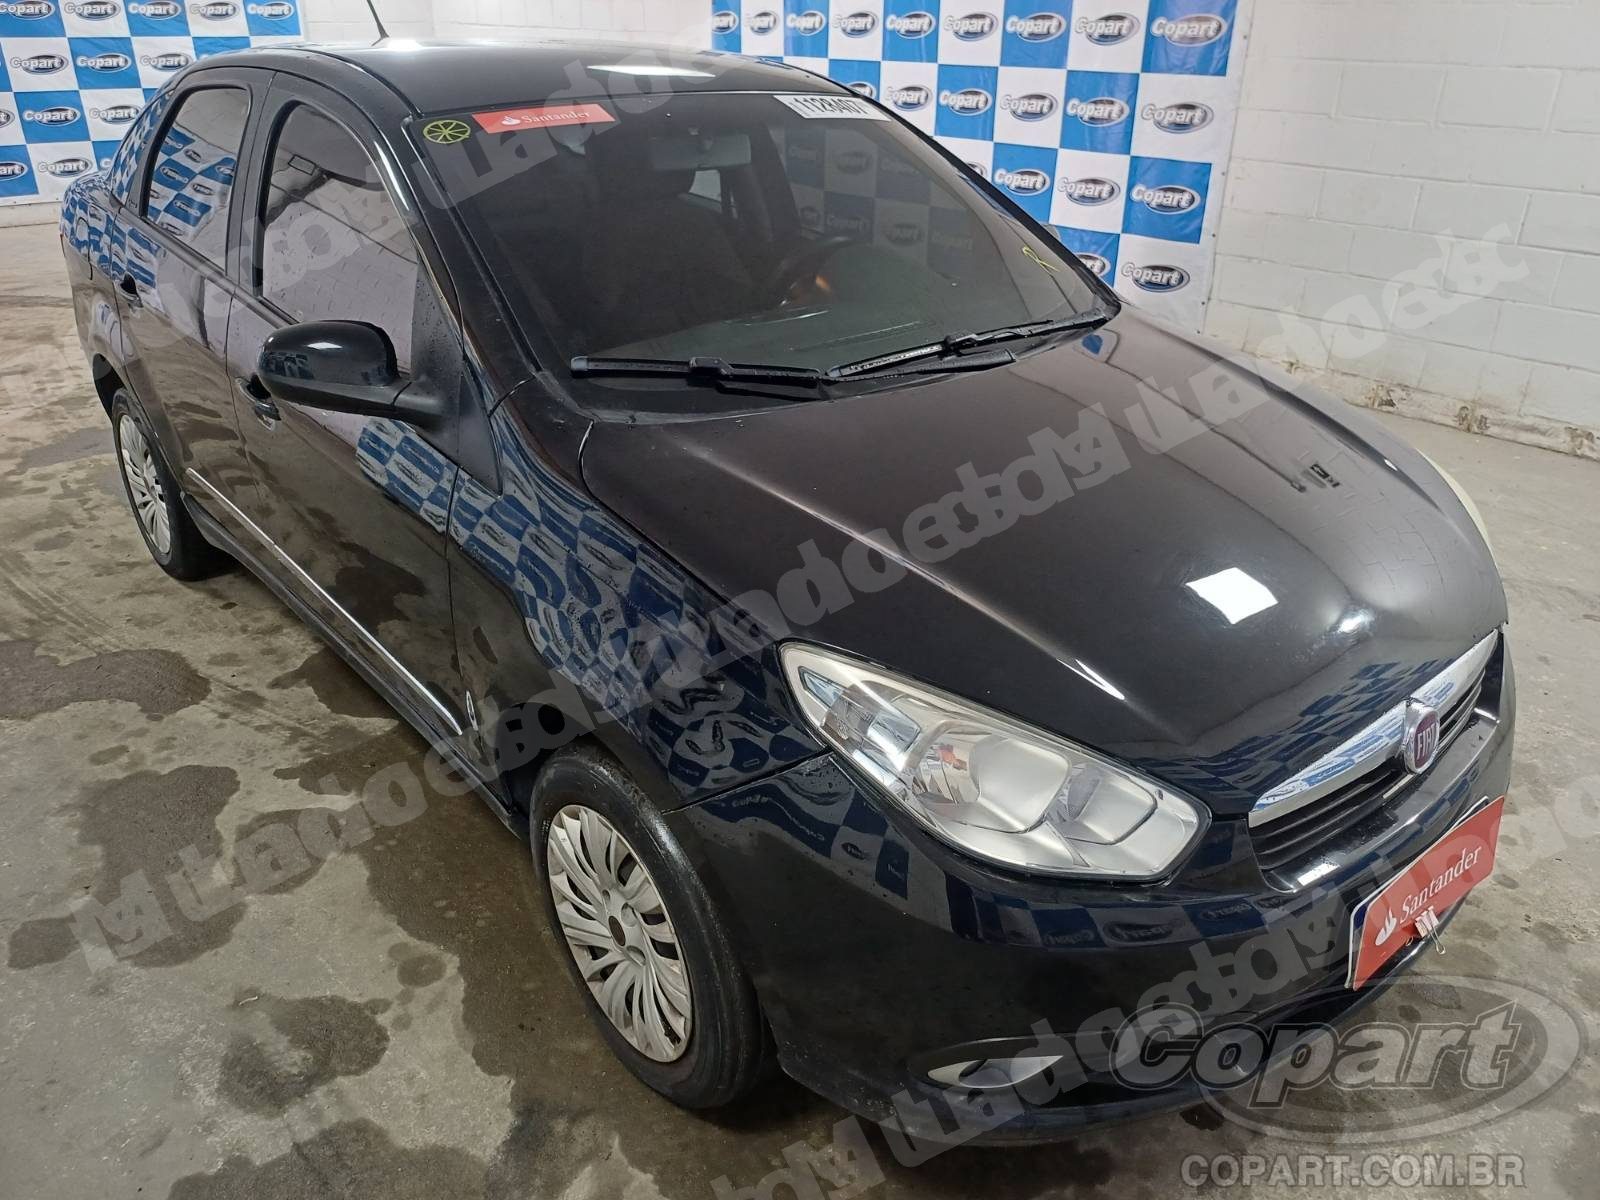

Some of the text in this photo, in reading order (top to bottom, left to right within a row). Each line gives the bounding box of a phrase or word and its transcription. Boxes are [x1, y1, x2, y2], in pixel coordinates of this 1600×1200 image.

[0, 1, 49, 15] Copart
[64, 2, 113, 15] Copart
[128, 2, 176, 16] Copart
[190, 3, 234, 17] Copart
[247, 3, 290, 17] Copart
[886, 14, 931, 32] Copart
[944, 15, 990, 34] Copart
[1006, 16, 1062, 35] Copart
[1074, 17, 1132, 37] Copart
[1151, 18, 1222, 39] Copart
[10, 56, 60, 72] Copart
[76, 55, 126, 69] Copart
[140, 55, 188, 70] Copart
[939, 90, 986, 110] Copart
[1000, 94, 1051, 114] Copart
[1067, 98, 1123, 121] Copart
[23, 109, 75, 123] Copart
[89, 107, 138, 121] Copart
[521, 110, 591, 124] Santander
[1141, 104, 1206, 127] Copart
[38, 161, 86, 175] Copart
[994, 168, 1045, 189] Copart
[1057, 177, 1113, 199] Copart
[1131, 183, 1192, 209] Copart
[1121, 262, 1181, 286] Copart
[1416, 723, 1438, 761] FIAT
[1400, 844, 1482, 924] Santander
